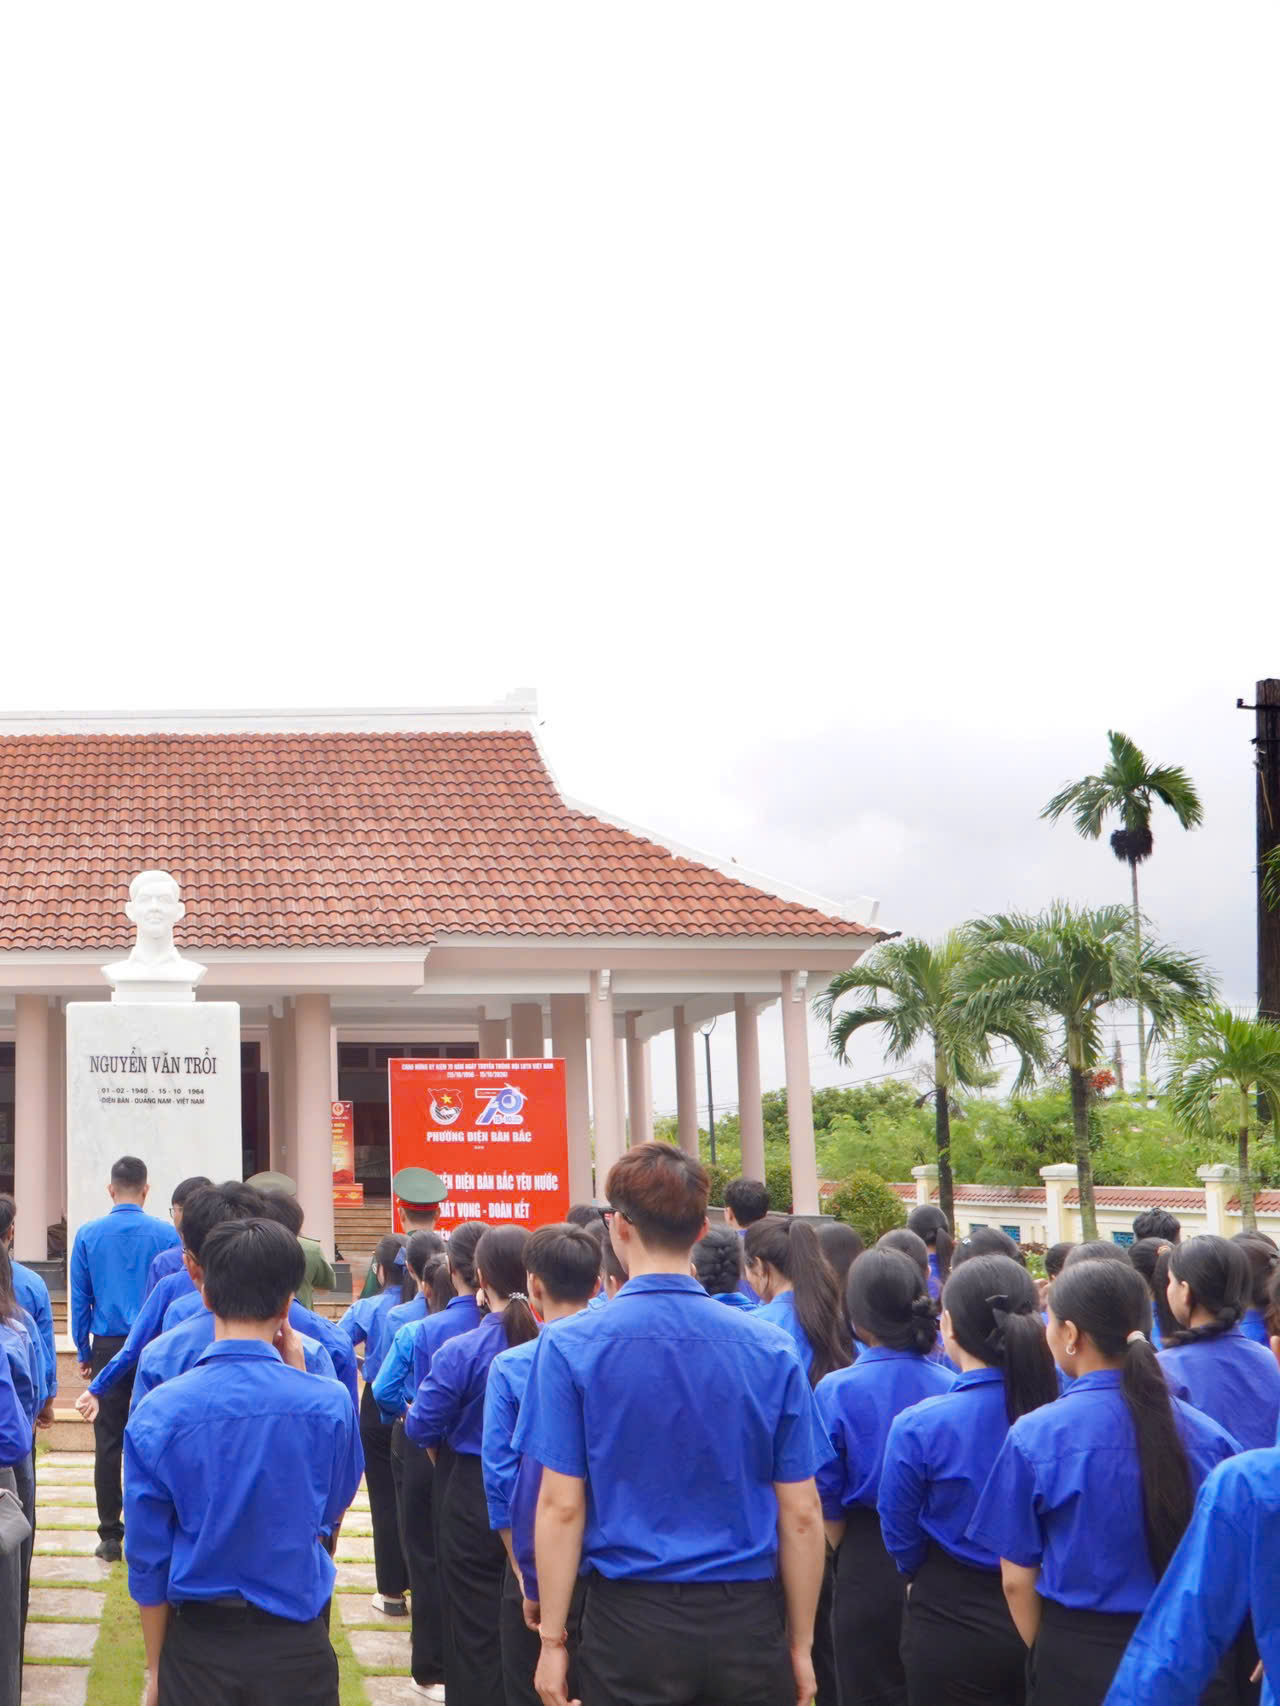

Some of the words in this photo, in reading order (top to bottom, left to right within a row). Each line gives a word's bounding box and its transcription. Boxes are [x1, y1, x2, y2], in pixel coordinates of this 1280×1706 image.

[152, 1051, 180, 1073] VĂN
[190, 1097, 205, 1105] NAM
[516, 1172, 532, 1190] YÊU
[457, 1202, 481, 1220] VỌNG
[514, 1198, 530, 1218] KẾT
